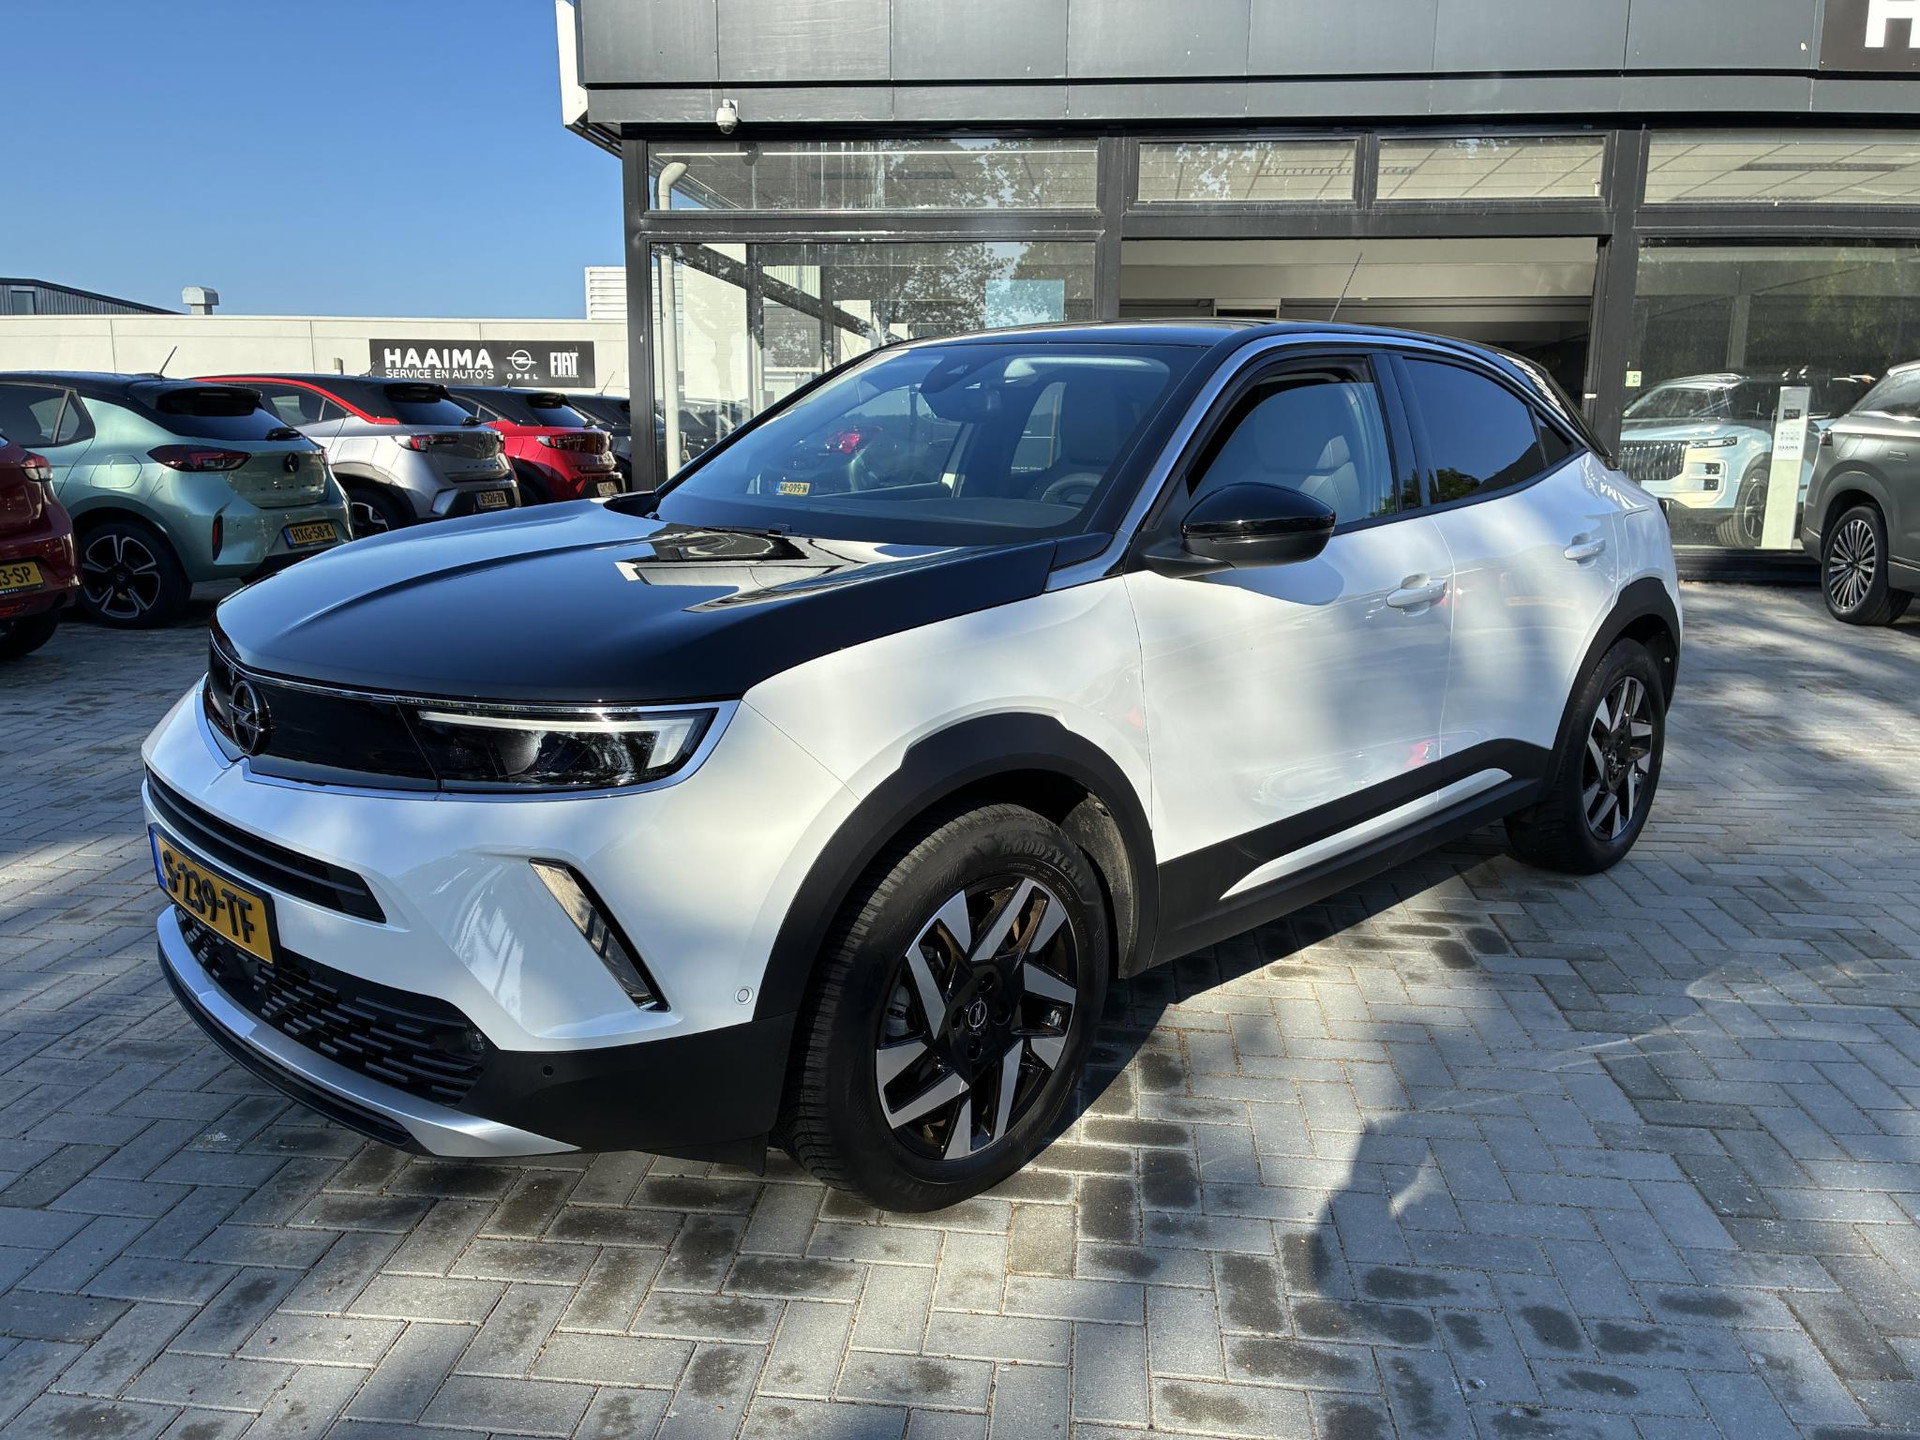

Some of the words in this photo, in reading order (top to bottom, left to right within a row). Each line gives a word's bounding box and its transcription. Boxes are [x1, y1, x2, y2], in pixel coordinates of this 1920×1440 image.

[384, 348, 494, 369] HAAIMA
[550, 352, 578, 374] FIAT
[385, 368, 431, 379] SERVICE
[434, 368, 450, 379] EN
[452, 368, 494, 379] AUTO'S
[163, 849, 255, 944] S-239-TF
